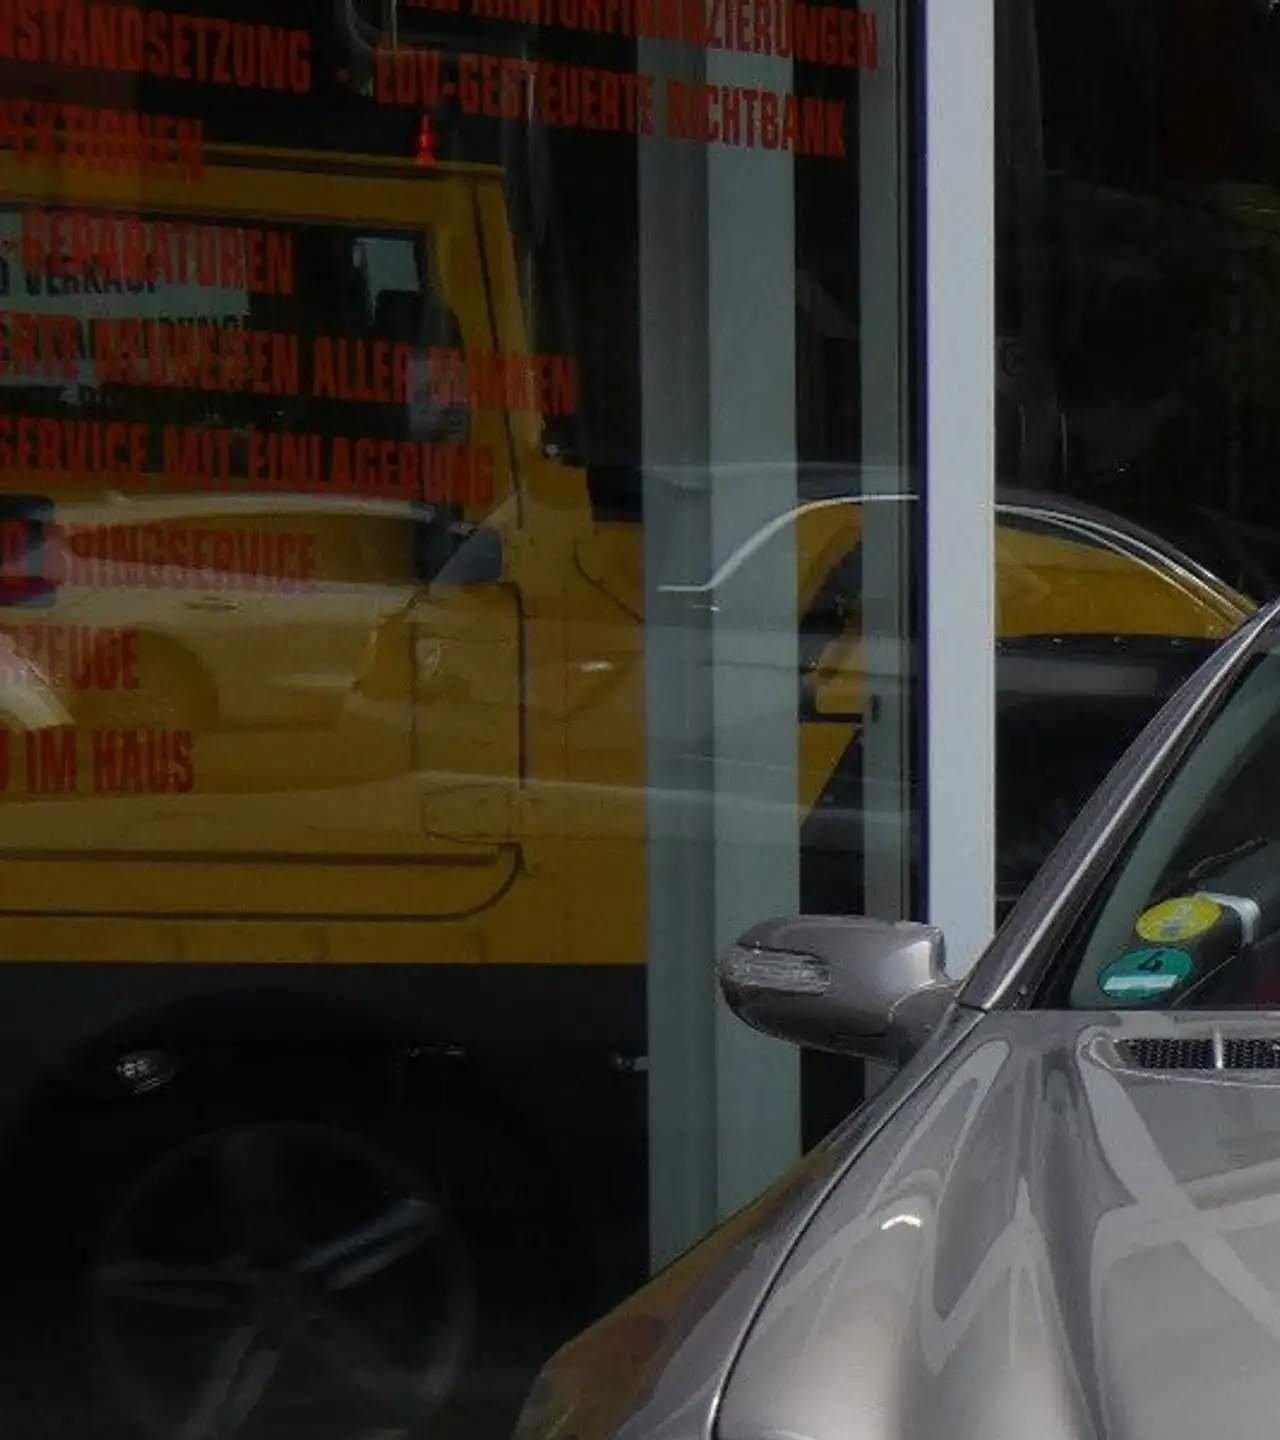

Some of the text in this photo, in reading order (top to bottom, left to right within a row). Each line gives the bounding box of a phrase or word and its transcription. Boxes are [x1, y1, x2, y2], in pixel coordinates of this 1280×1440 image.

[376, 46, 654, 135] EDV-GESTEUERTE
[667, 79, 847, 162] RICHTBANK
[312, 335, 413, 404] ALLER
[247, 428, 495, 508] EINLAGERUNG
[26, 728, 77, 793] IM
[92, 728, 194, 794] HAUS
